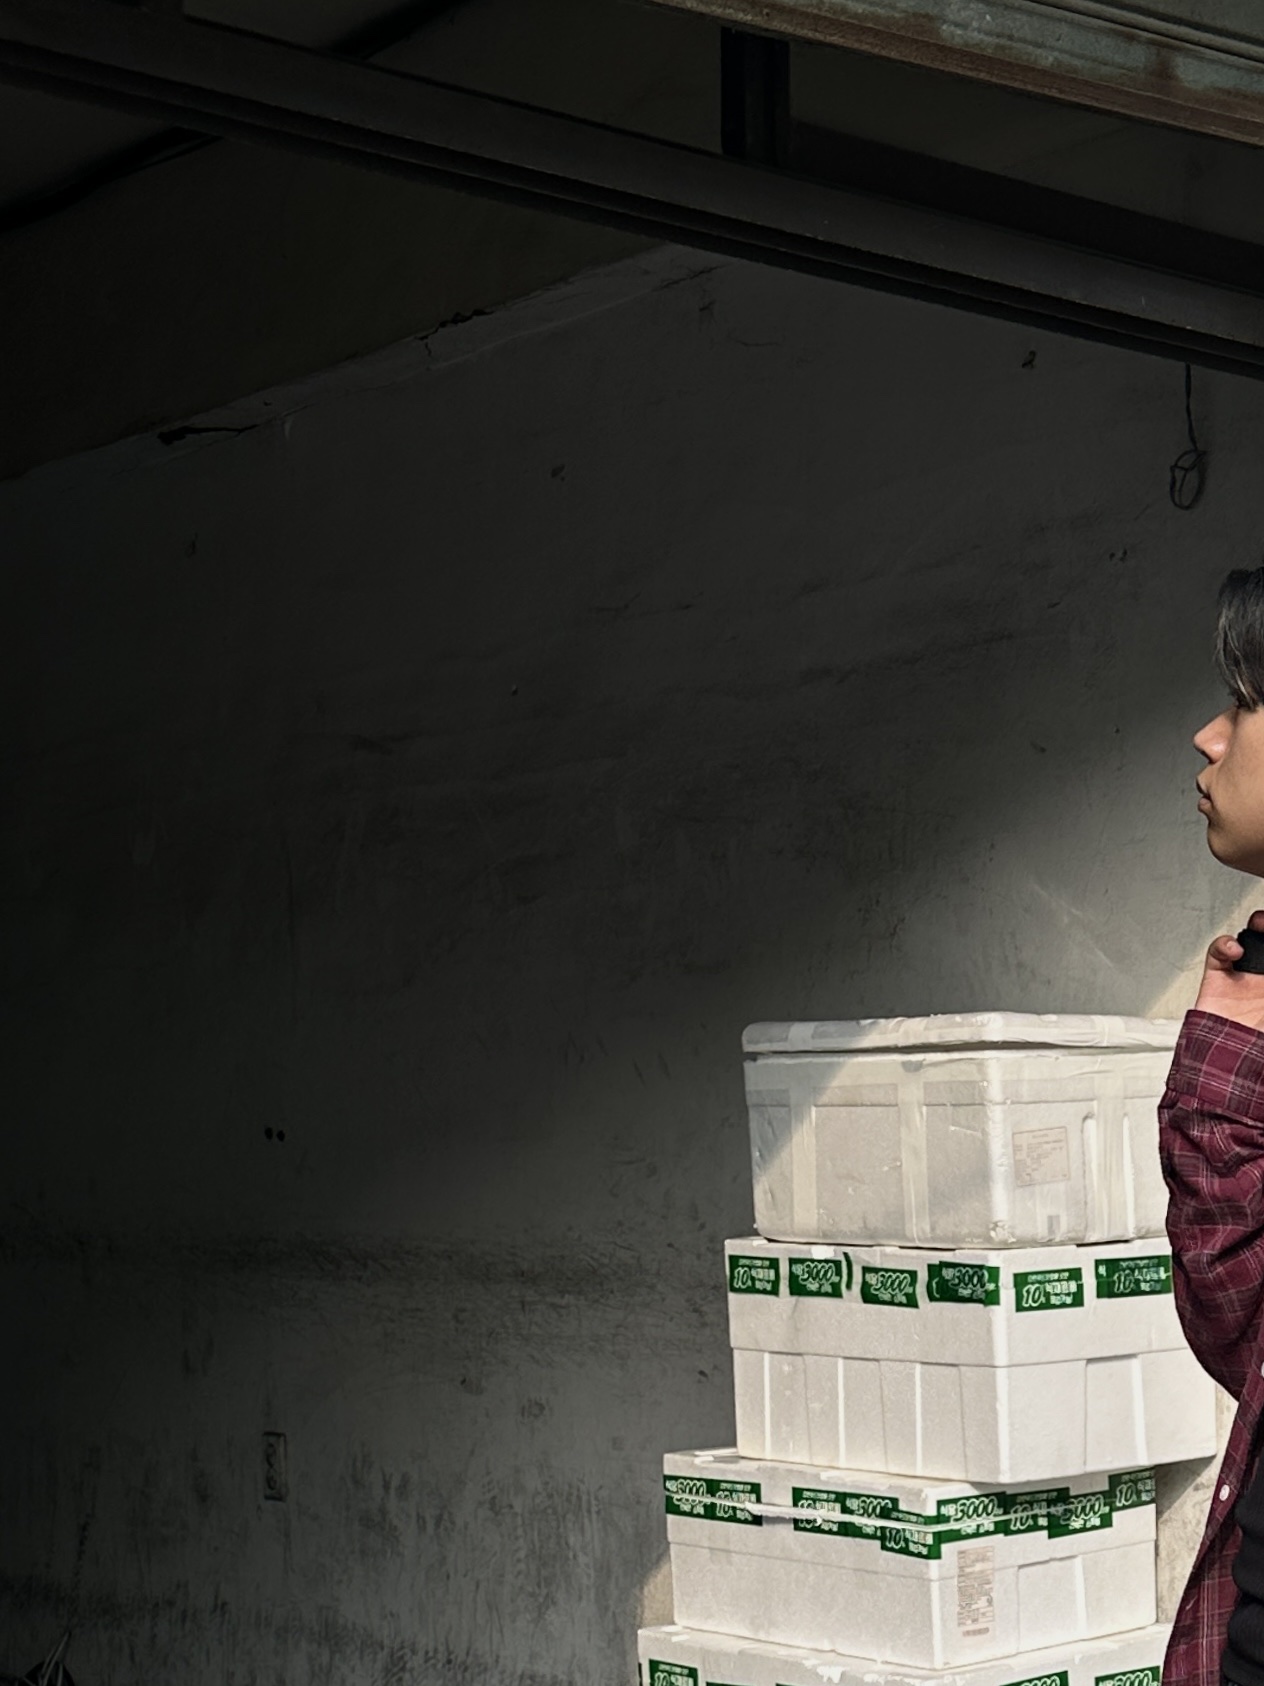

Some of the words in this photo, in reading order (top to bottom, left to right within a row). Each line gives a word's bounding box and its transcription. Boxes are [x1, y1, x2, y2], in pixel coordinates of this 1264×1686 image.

[799, 1261, 836, 1286] 3000
[871, 1271, 911, 1295] 3000
[1022, 1284, 1044, 1307] 10
[1116, 1483, 1135, 1507] 10
[952, 1496, 998, 1523] 3000
